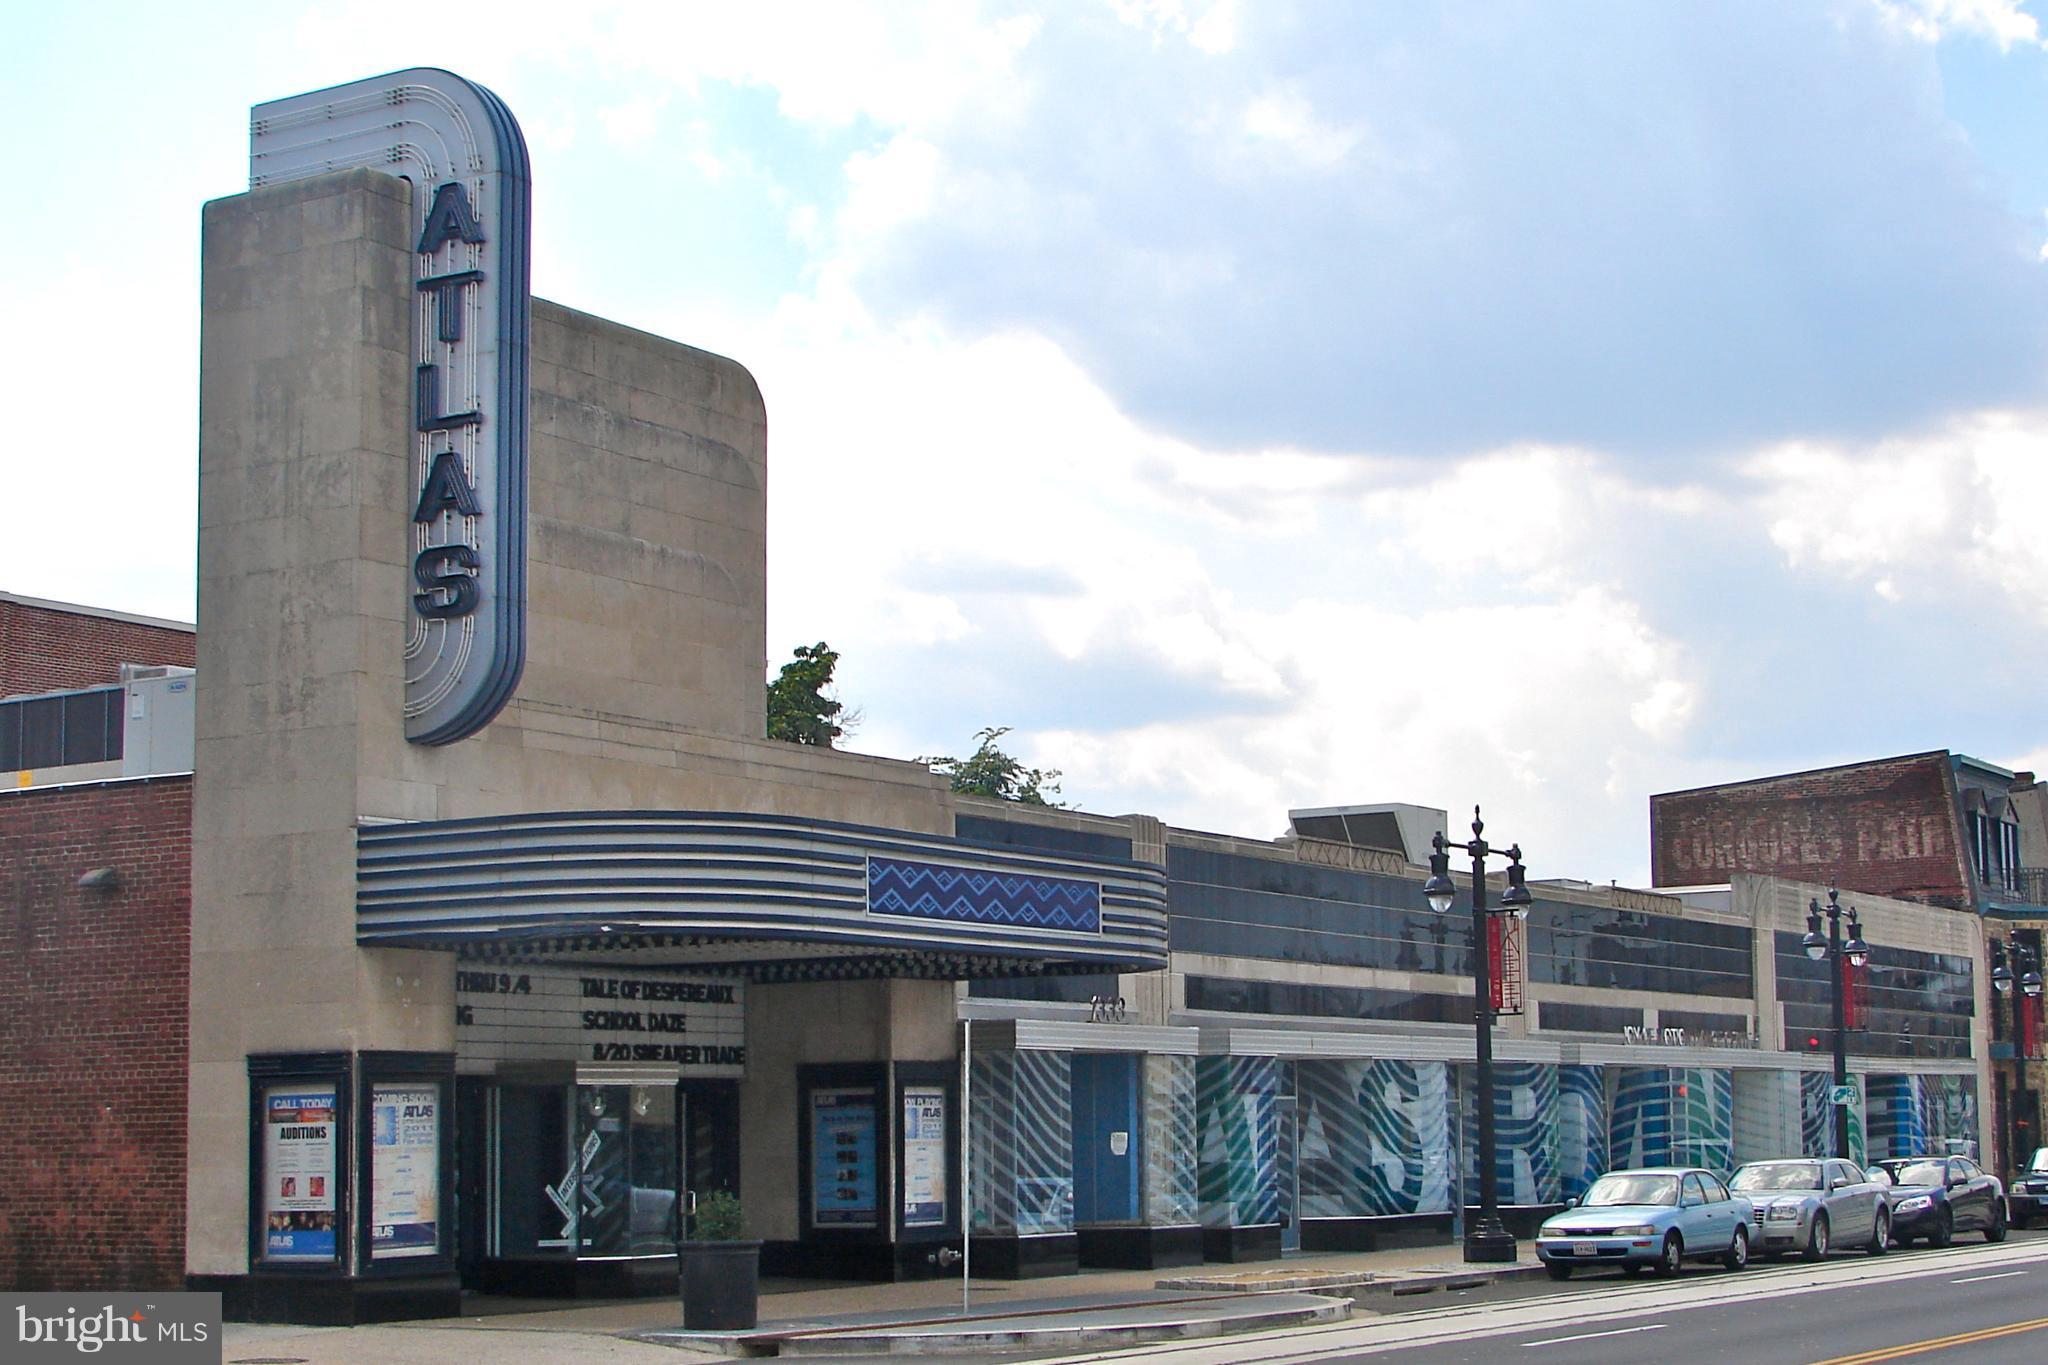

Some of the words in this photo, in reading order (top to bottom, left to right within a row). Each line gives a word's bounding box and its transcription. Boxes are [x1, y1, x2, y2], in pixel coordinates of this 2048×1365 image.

[414, 182, 485, 619] ATLAS
[580, 977, 618, 998] TALE
[620, 980, 643, 1000] OF
[643, 982, 735, 1004] DESPEREAUX
[582, 1010, 645, 1032] SCHOOL
[647, 1013, 687, 1034] DAZE
[593, 1043, 631, 1061] 8/20
[632, 1045, 701, 1065] SNEAKER
[703, 1046, 746, 1065] TRADE
[274, 1098, 300, 1110] CALL
[301, 1098, 333, 1109] TODAY
[403, 1105, 434, 1118] ATLAS
[280, 1127, 327, 1140] AUDITIONS
